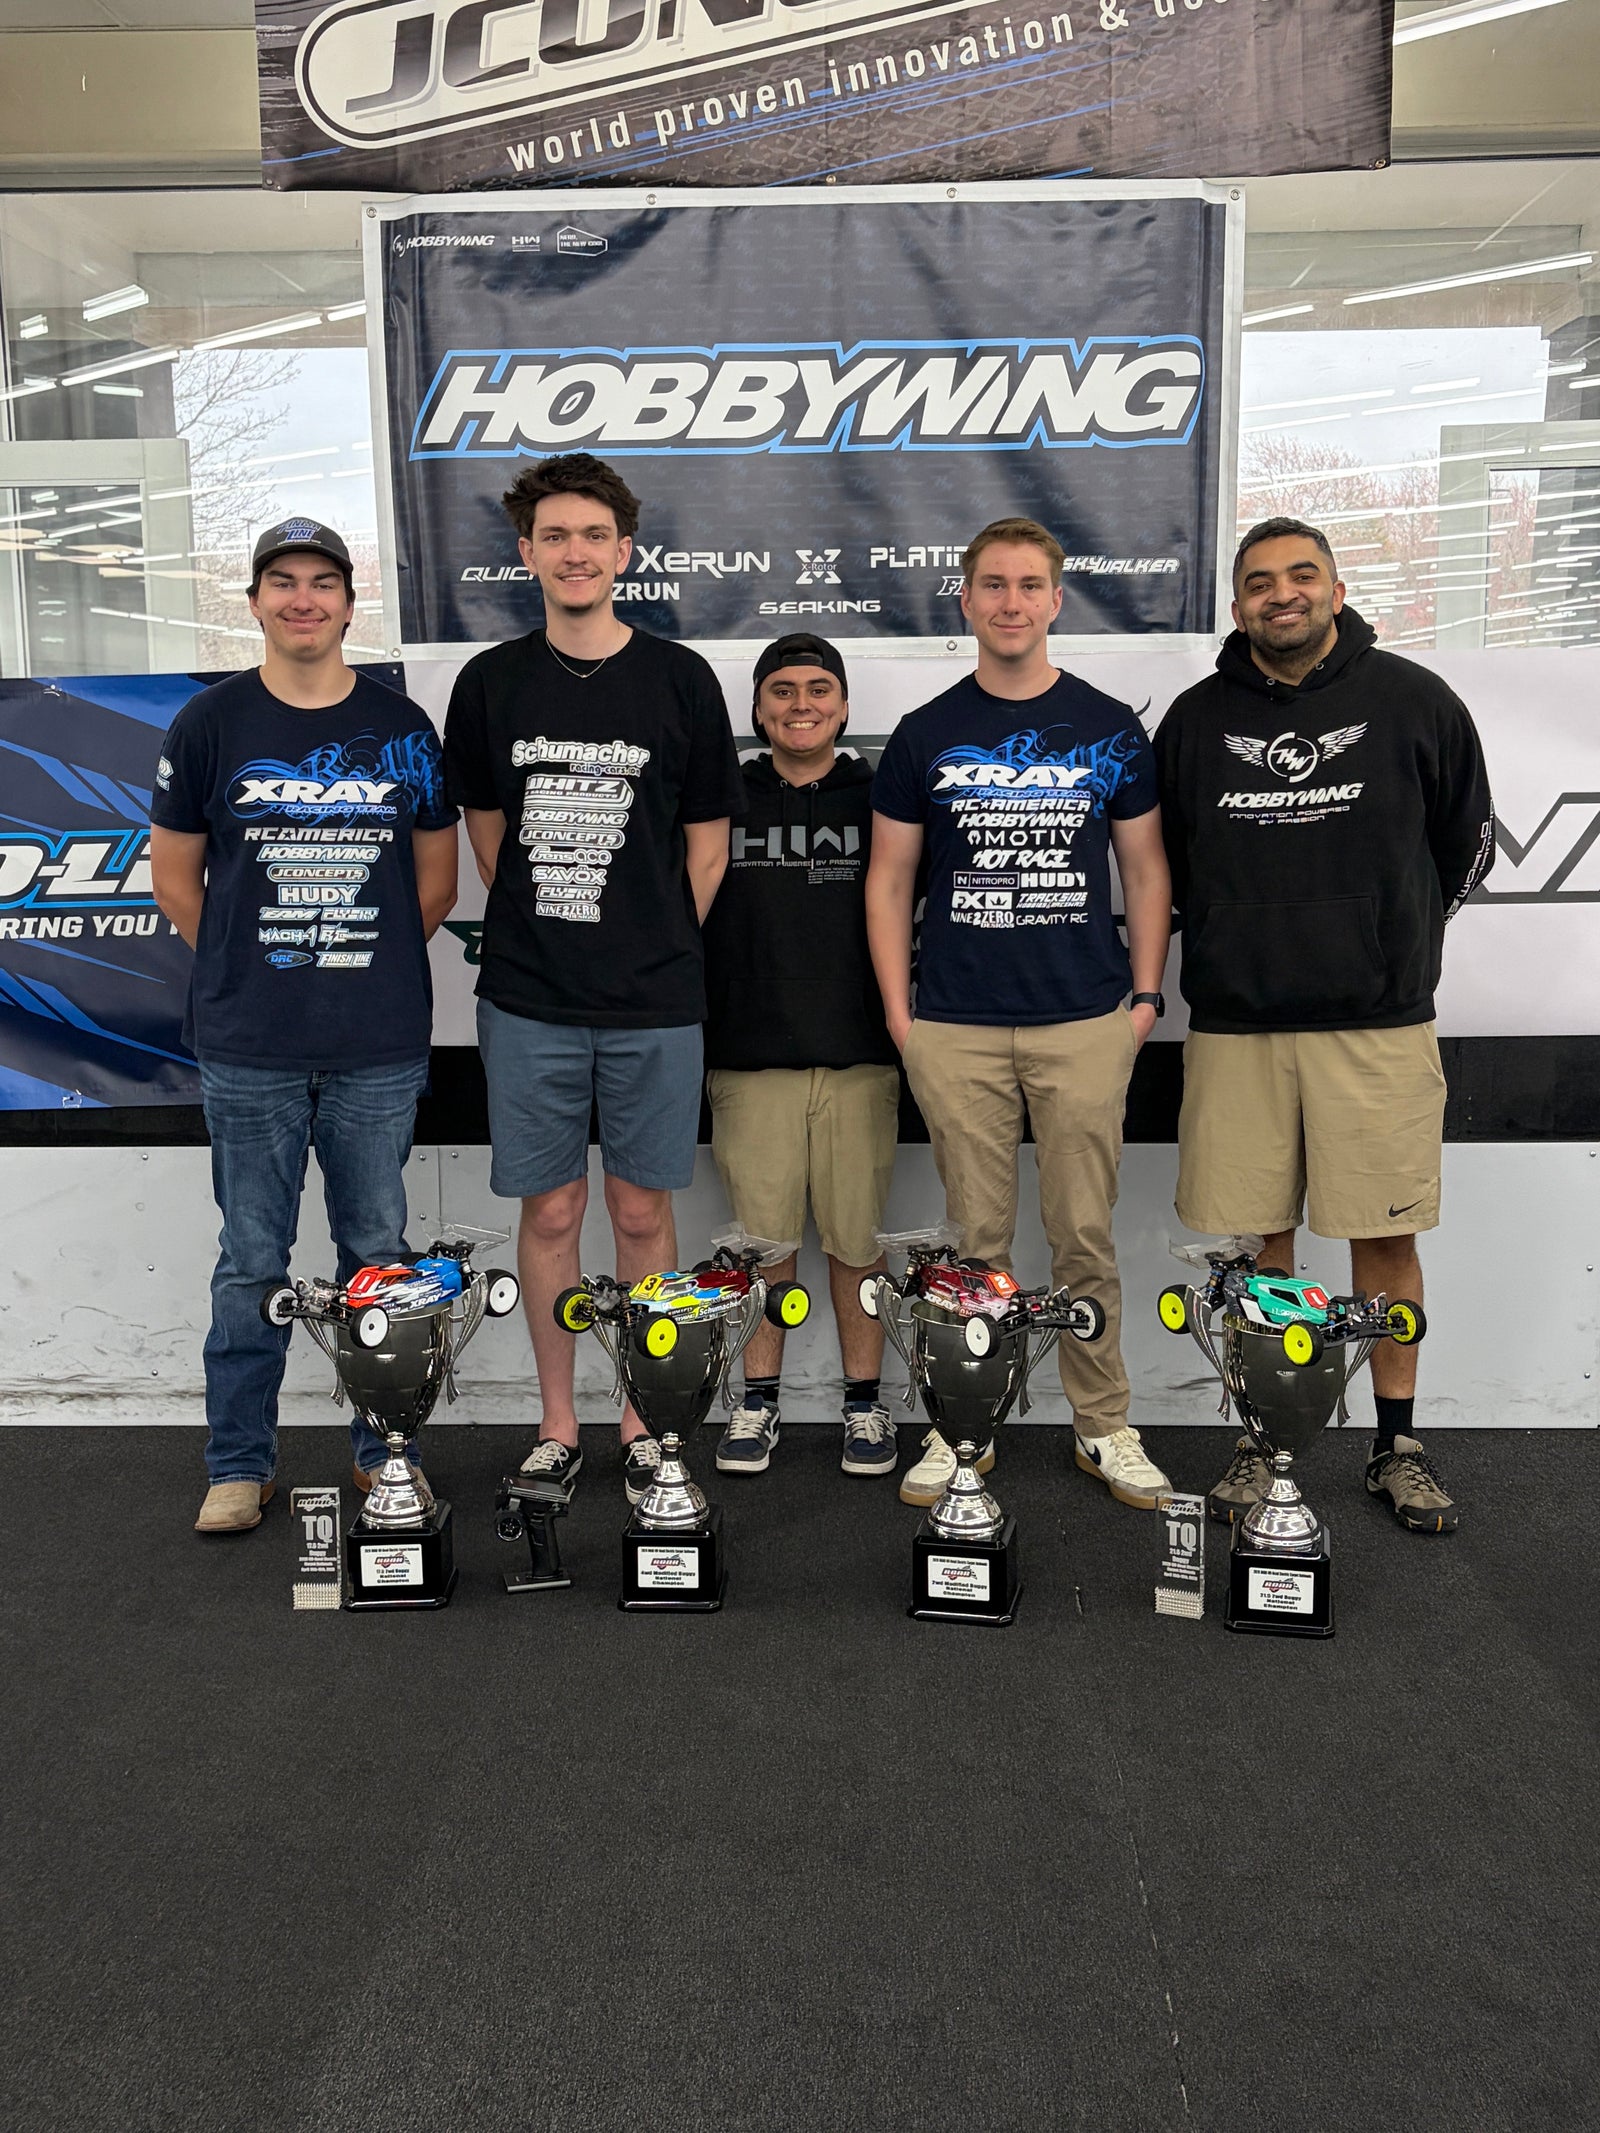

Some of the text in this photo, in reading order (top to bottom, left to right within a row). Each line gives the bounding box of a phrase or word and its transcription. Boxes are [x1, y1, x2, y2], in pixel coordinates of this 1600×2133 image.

[507, 0, 1129, 172] world proven innovation &
[405, 235, 495, 249] HOBBYWING
[420, 348, 1203, 446] HOBBYWING
[1061, 555, 1181, 576] SKYWALKER
[759, 600, 881, 615] SEAKING
[512, 737, 650, 767] Schumacher
[932, 764, 1094, 792] XRAY
[235, 779, 398, 805] XRAY
[1046, 790, 1091, 799] TEAM
[1217, 783, 1364, 809] HOBBYWING
[951, 799, 1092, 813] RC AMERICA
[523, 809, 627, 827] HOBBYWING
[956, 811, 1086, 829] HOBBYWING
[1229, 811, 1294, 820] INNOVATION
[523, 829, 618, 846] JCONCEPTS
[985, 829, 1076, 847] MOTIV
[259, 845, 379, 862] HOBBYWING
[971, 848, 1072, 870] HOT RACE
[273, 867, 364, 880] JCONCEPTS
[972, 876, 1016, 886] NITROPRO
[1020, 872, 1087, 888] HUDY
[279, 886, 359, 904] HUDY
[1019, 891, 1089, 903] TRACKSIDE
[92, 914, 159, 937] YOU
[1015, 912, 1089, 926] GRAVITY RC
[644, 1277, 659, 1291] 3
[993, 1274, 1011, 1290] 2
[410, 1293, 441, 1309] XRAY
[301, 1515, 334, 1544] TQ
[1165, 1520, 1197, 1552] TQ
